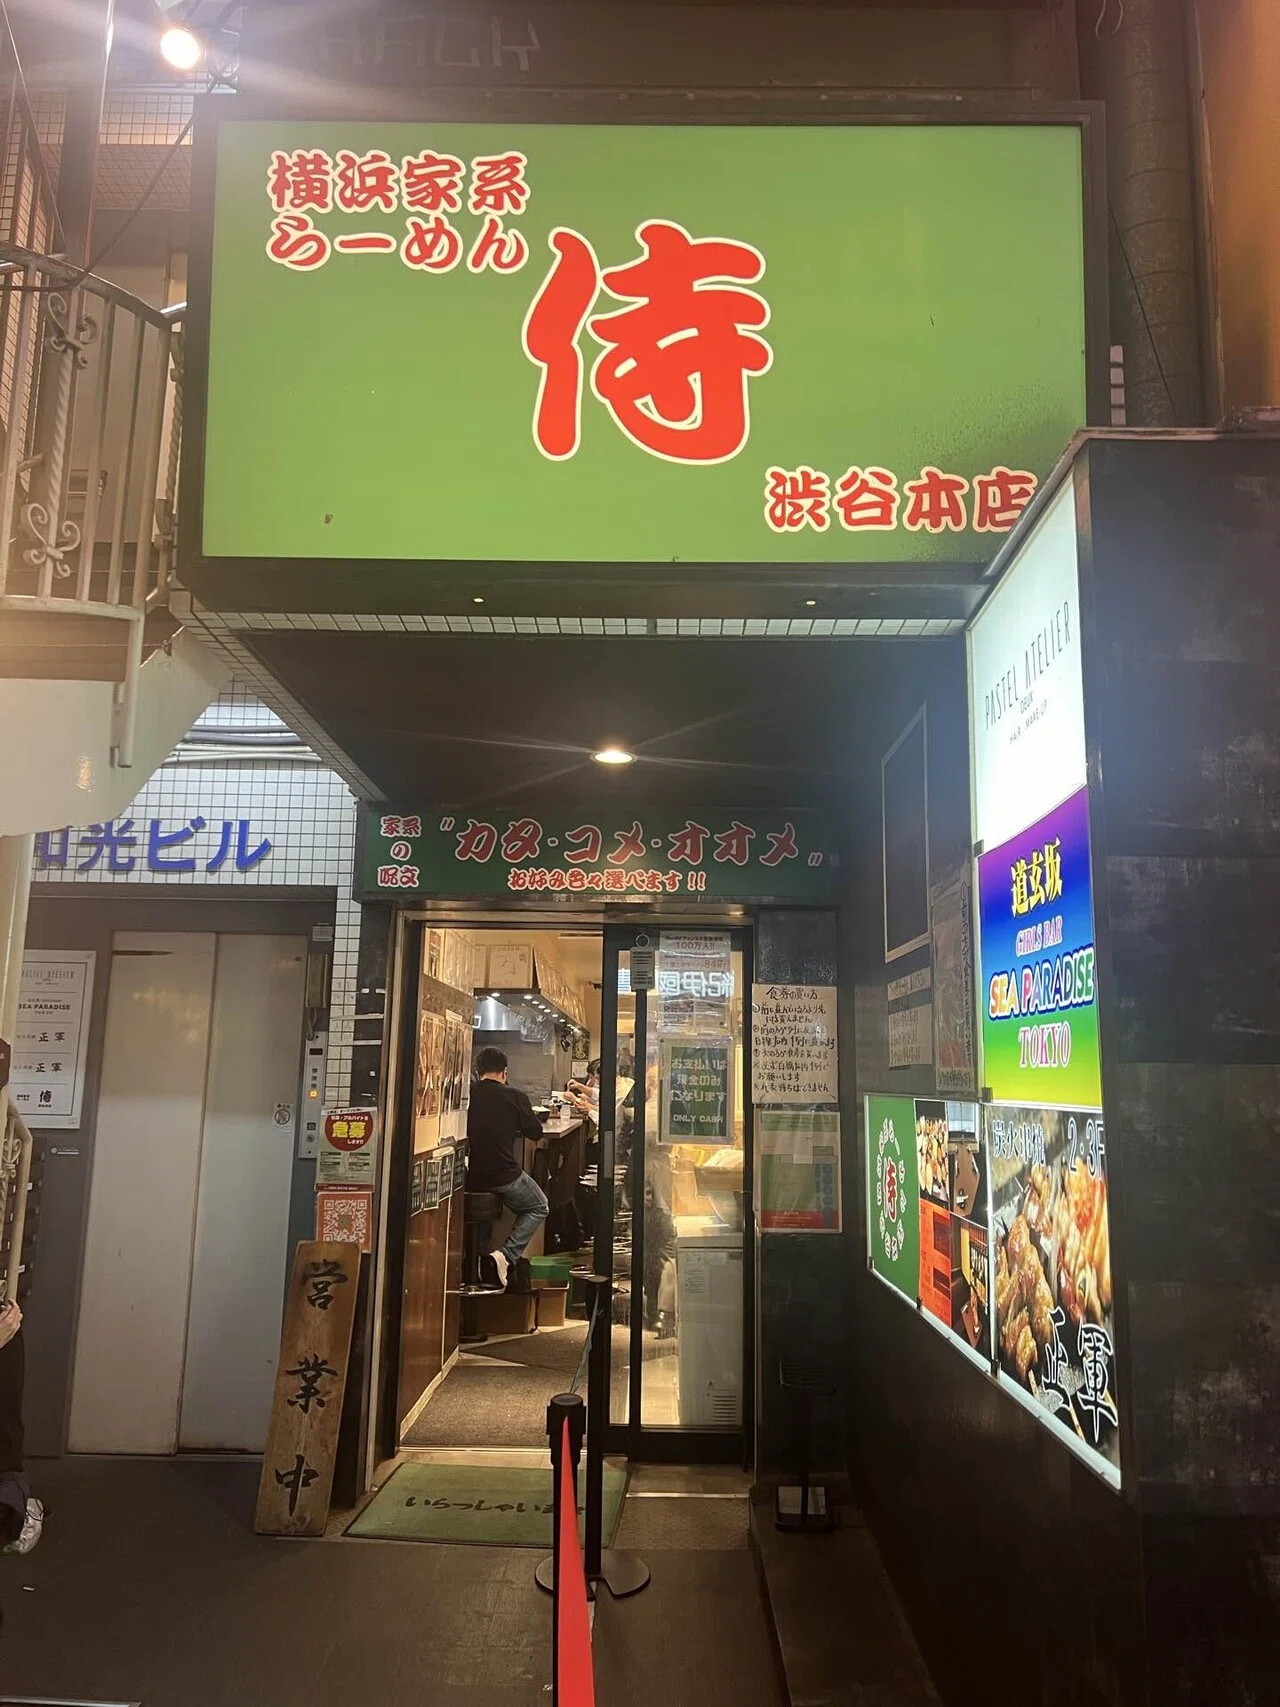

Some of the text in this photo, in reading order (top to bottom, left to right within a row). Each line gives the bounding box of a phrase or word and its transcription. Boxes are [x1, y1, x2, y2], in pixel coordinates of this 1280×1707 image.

[267, 148, 531, 216] 横浜家系
[266, 214, 530, 274] らーめん
[521, 218, 774, 465] 侍
[764, 465, 1038, 533] 渋谷本店
[985, 601, 1070, 730] PASTEL ATELIER
[380, 815, 422, 837] 家系
[390, 841, 412, 861] の
[378, 864, 420, 888] 呪文
[1011, 836, 1064, 918] 道玄坂
[1016, 915, 1063, 956] GIRLS BAR
[766, 986, 819, 1001] 食券の買い方
[988, 967, 1019, 1022] SEA
[1020, 943, 1095, 1016] PARADISE
[34, 1003, 71, 1011] PARADISE
[1018, 1021, 1071, 1068] TOKYO
[332, 1121, 366, 1138] 急募
[673, 1114, 724, 1123] ONLY CASH
[993, 1119, 1046, 1166] 炭火串焼
[883, 1156, 898, 1222] 侍
[274, 1258, 348, 1517] 営業中
